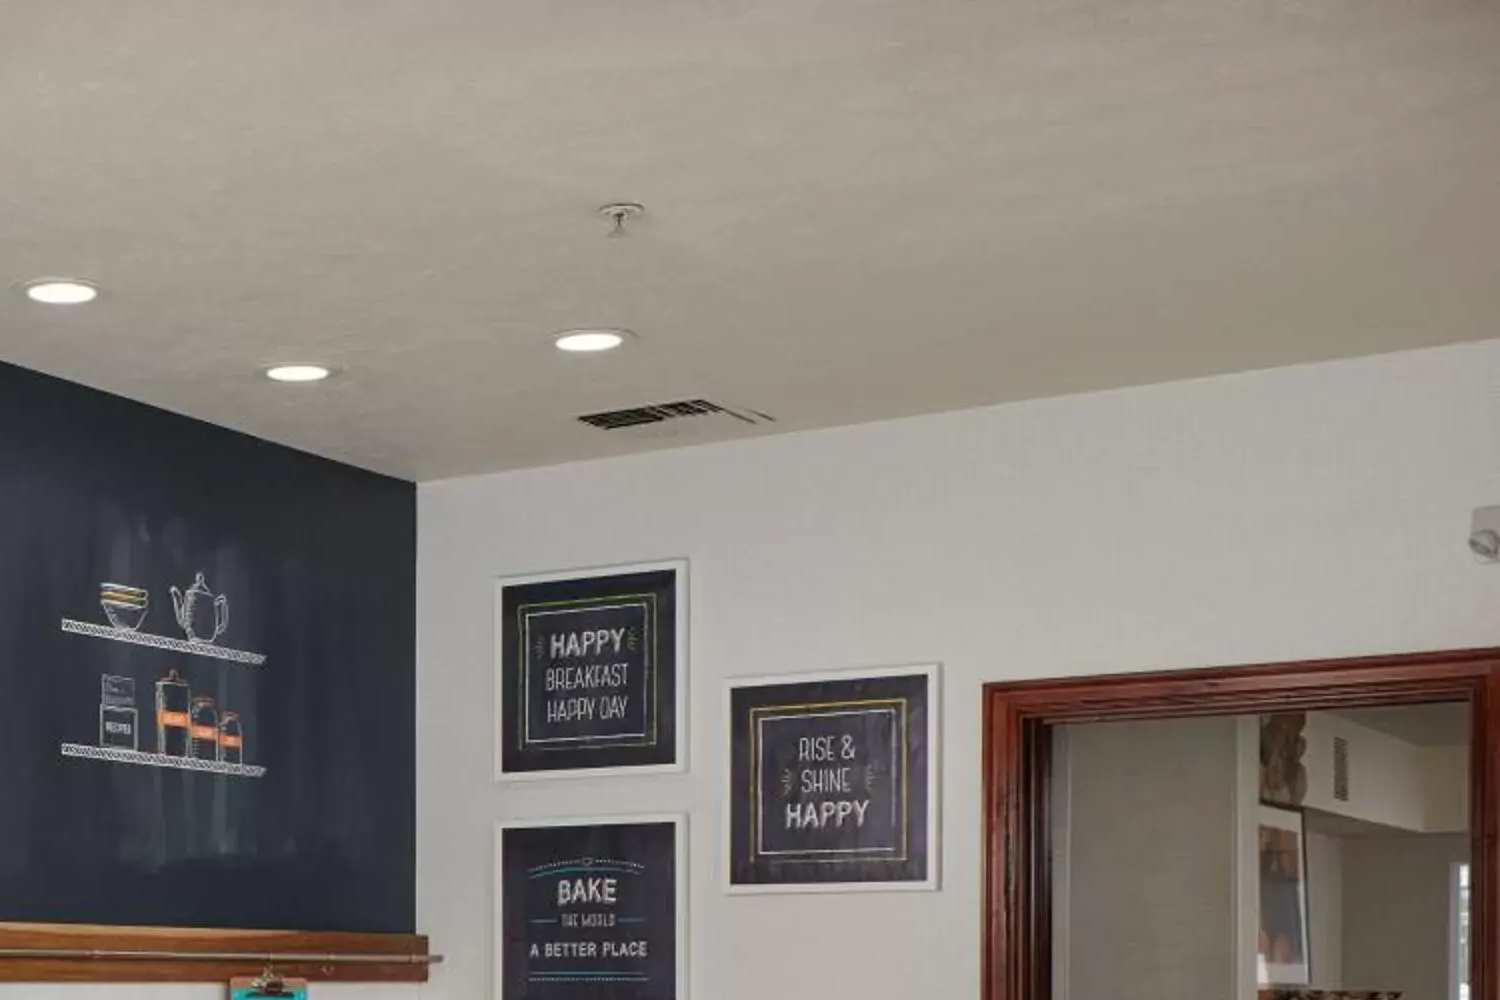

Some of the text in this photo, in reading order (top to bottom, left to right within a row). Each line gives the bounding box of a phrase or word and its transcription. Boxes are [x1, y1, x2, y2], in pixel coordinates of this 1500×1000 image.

[550, 627, 625, 659] HAPPY
[545, 662, 628, 691] BREAKFAST
[547, 695, 628, 723] HAPPY DAY
[799, 734, 856, 761] RISE &
[801, 767, 852, 793] SHINE
[786, 799, 869, 830] HAPPY
[558, 878, 617, 905] BAKE
[529, 941, 648, 958] A BETTER PLACE
